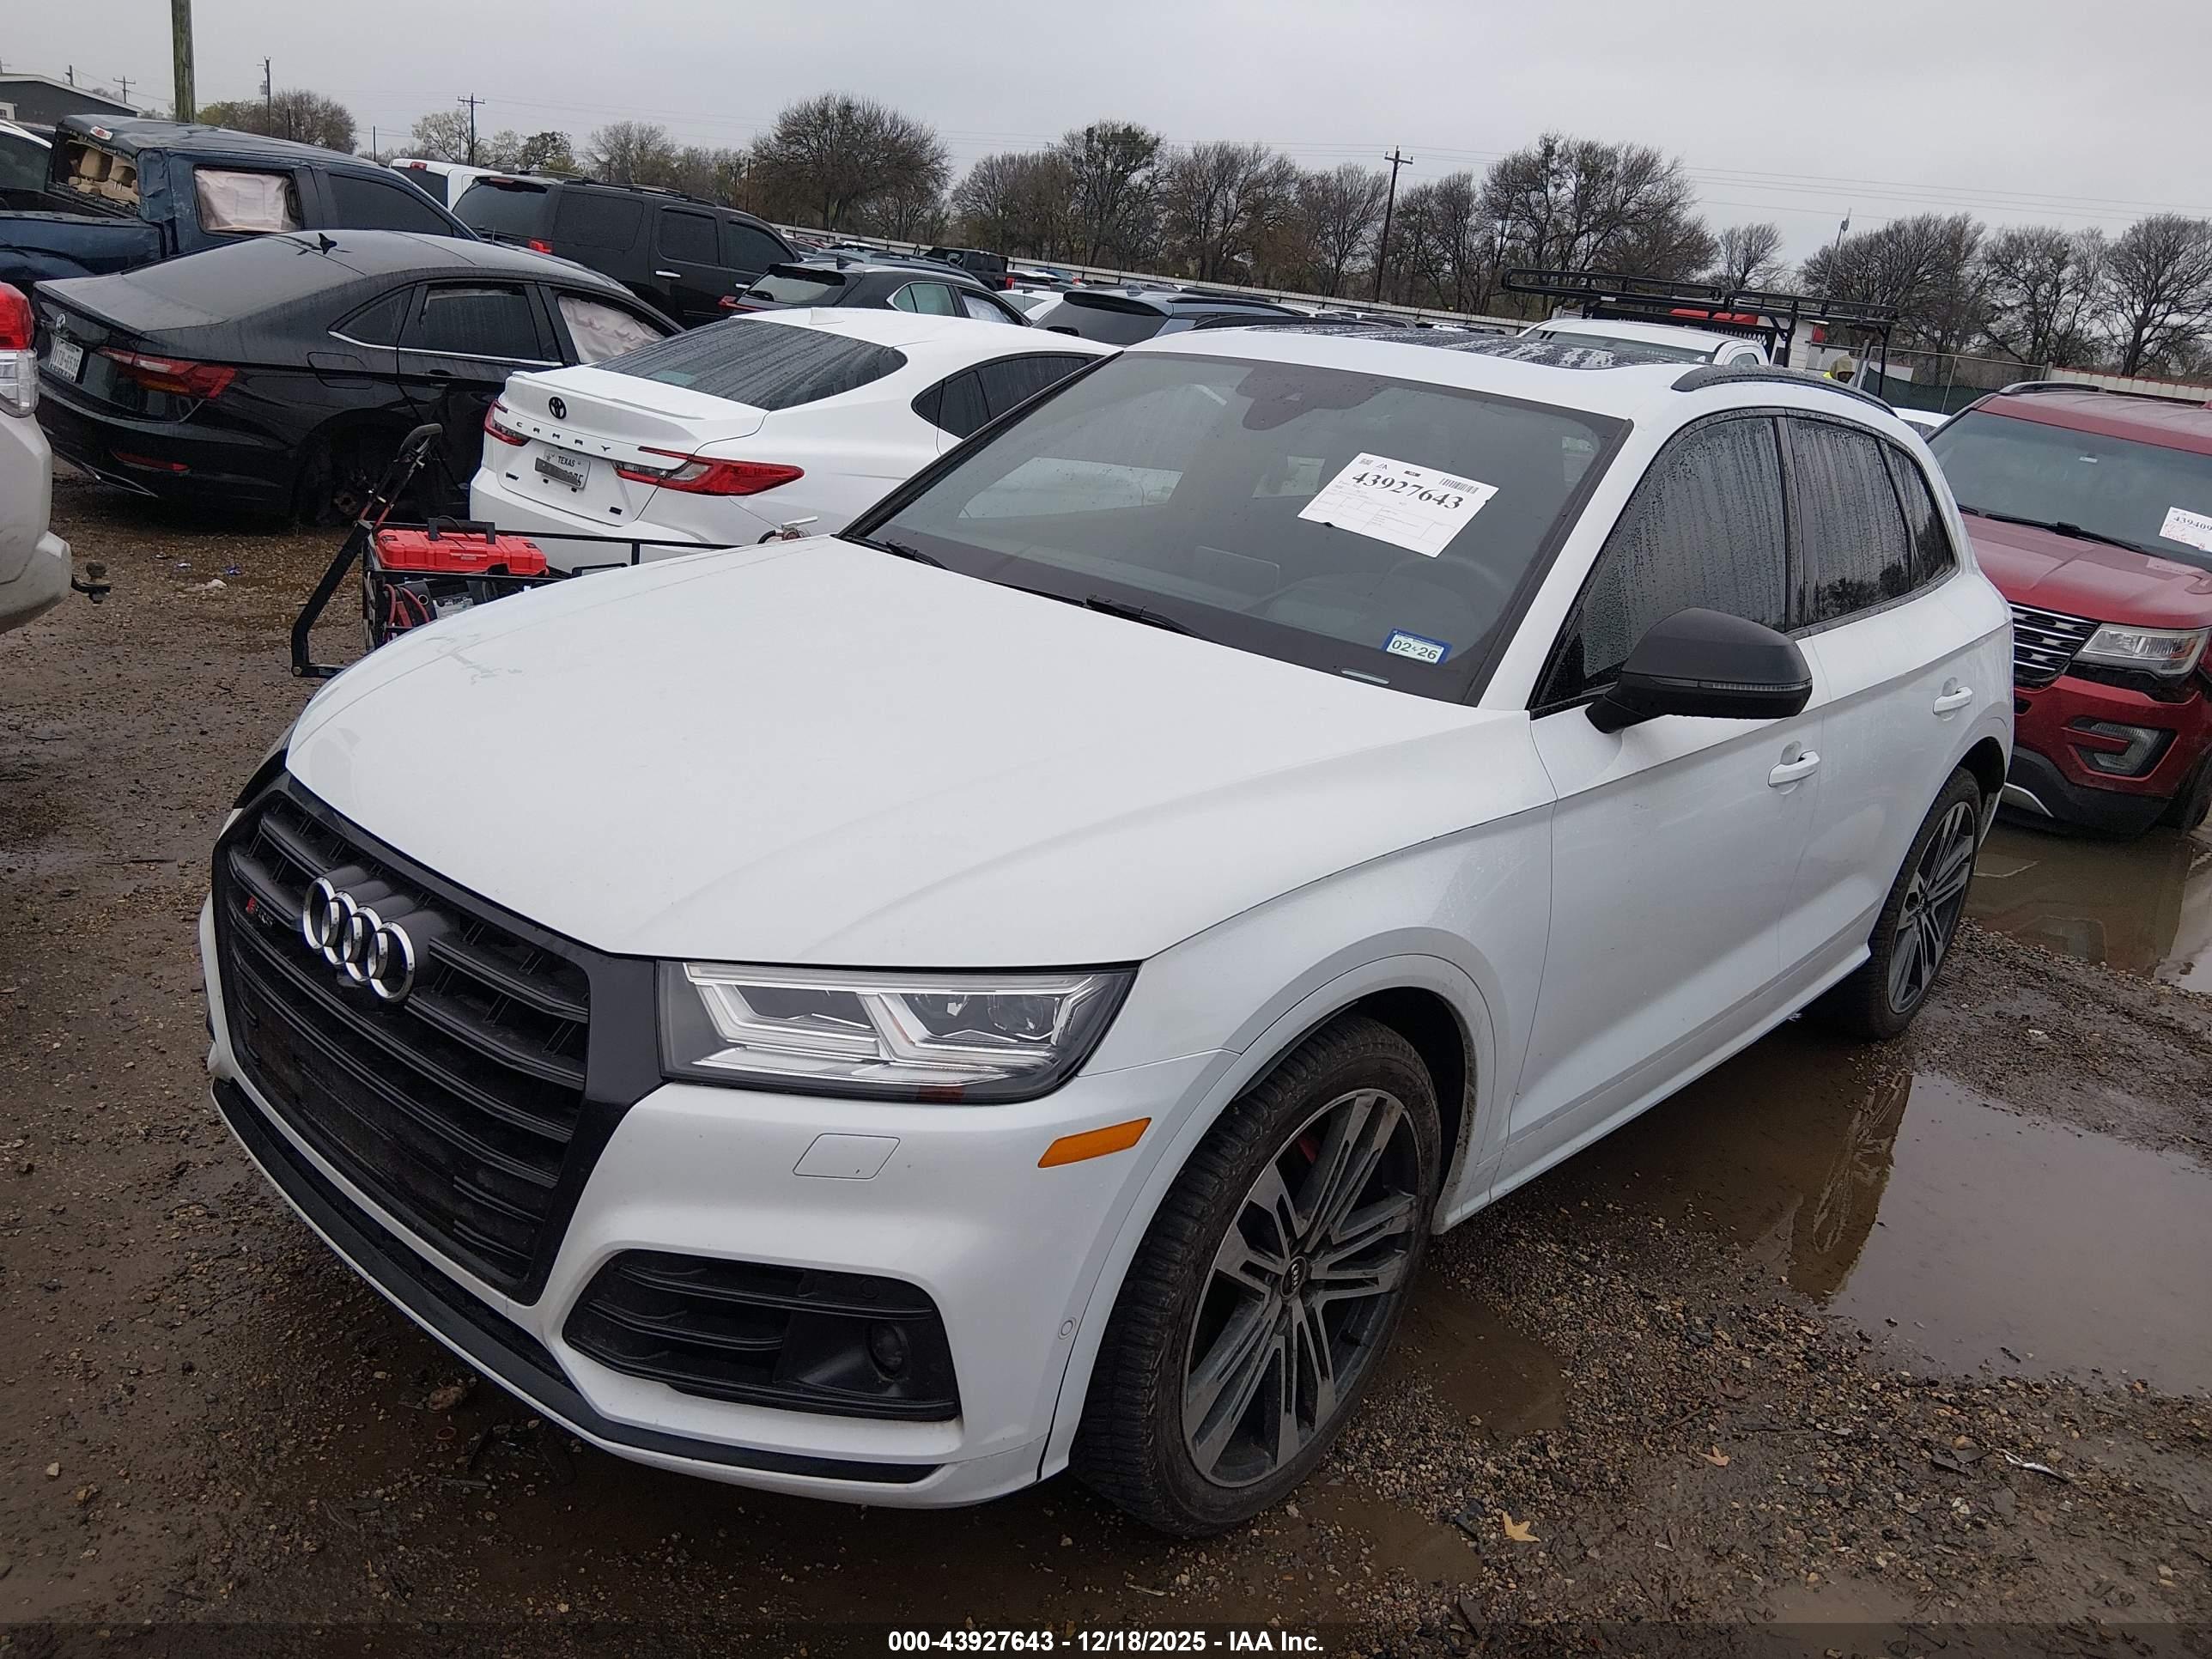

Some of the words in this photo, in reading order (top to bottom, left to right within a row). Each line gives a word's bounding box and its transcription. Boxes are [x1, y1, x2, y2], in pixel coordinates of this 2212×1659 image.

[516, 422, 611, 452] CAMRY
[557, 455, 575, 467] TEXAS
[1352, 471, 1463, 509] 43927643
[1392, 640, 1412, 653] 02
[1417, 647, 1437, 659] 26
